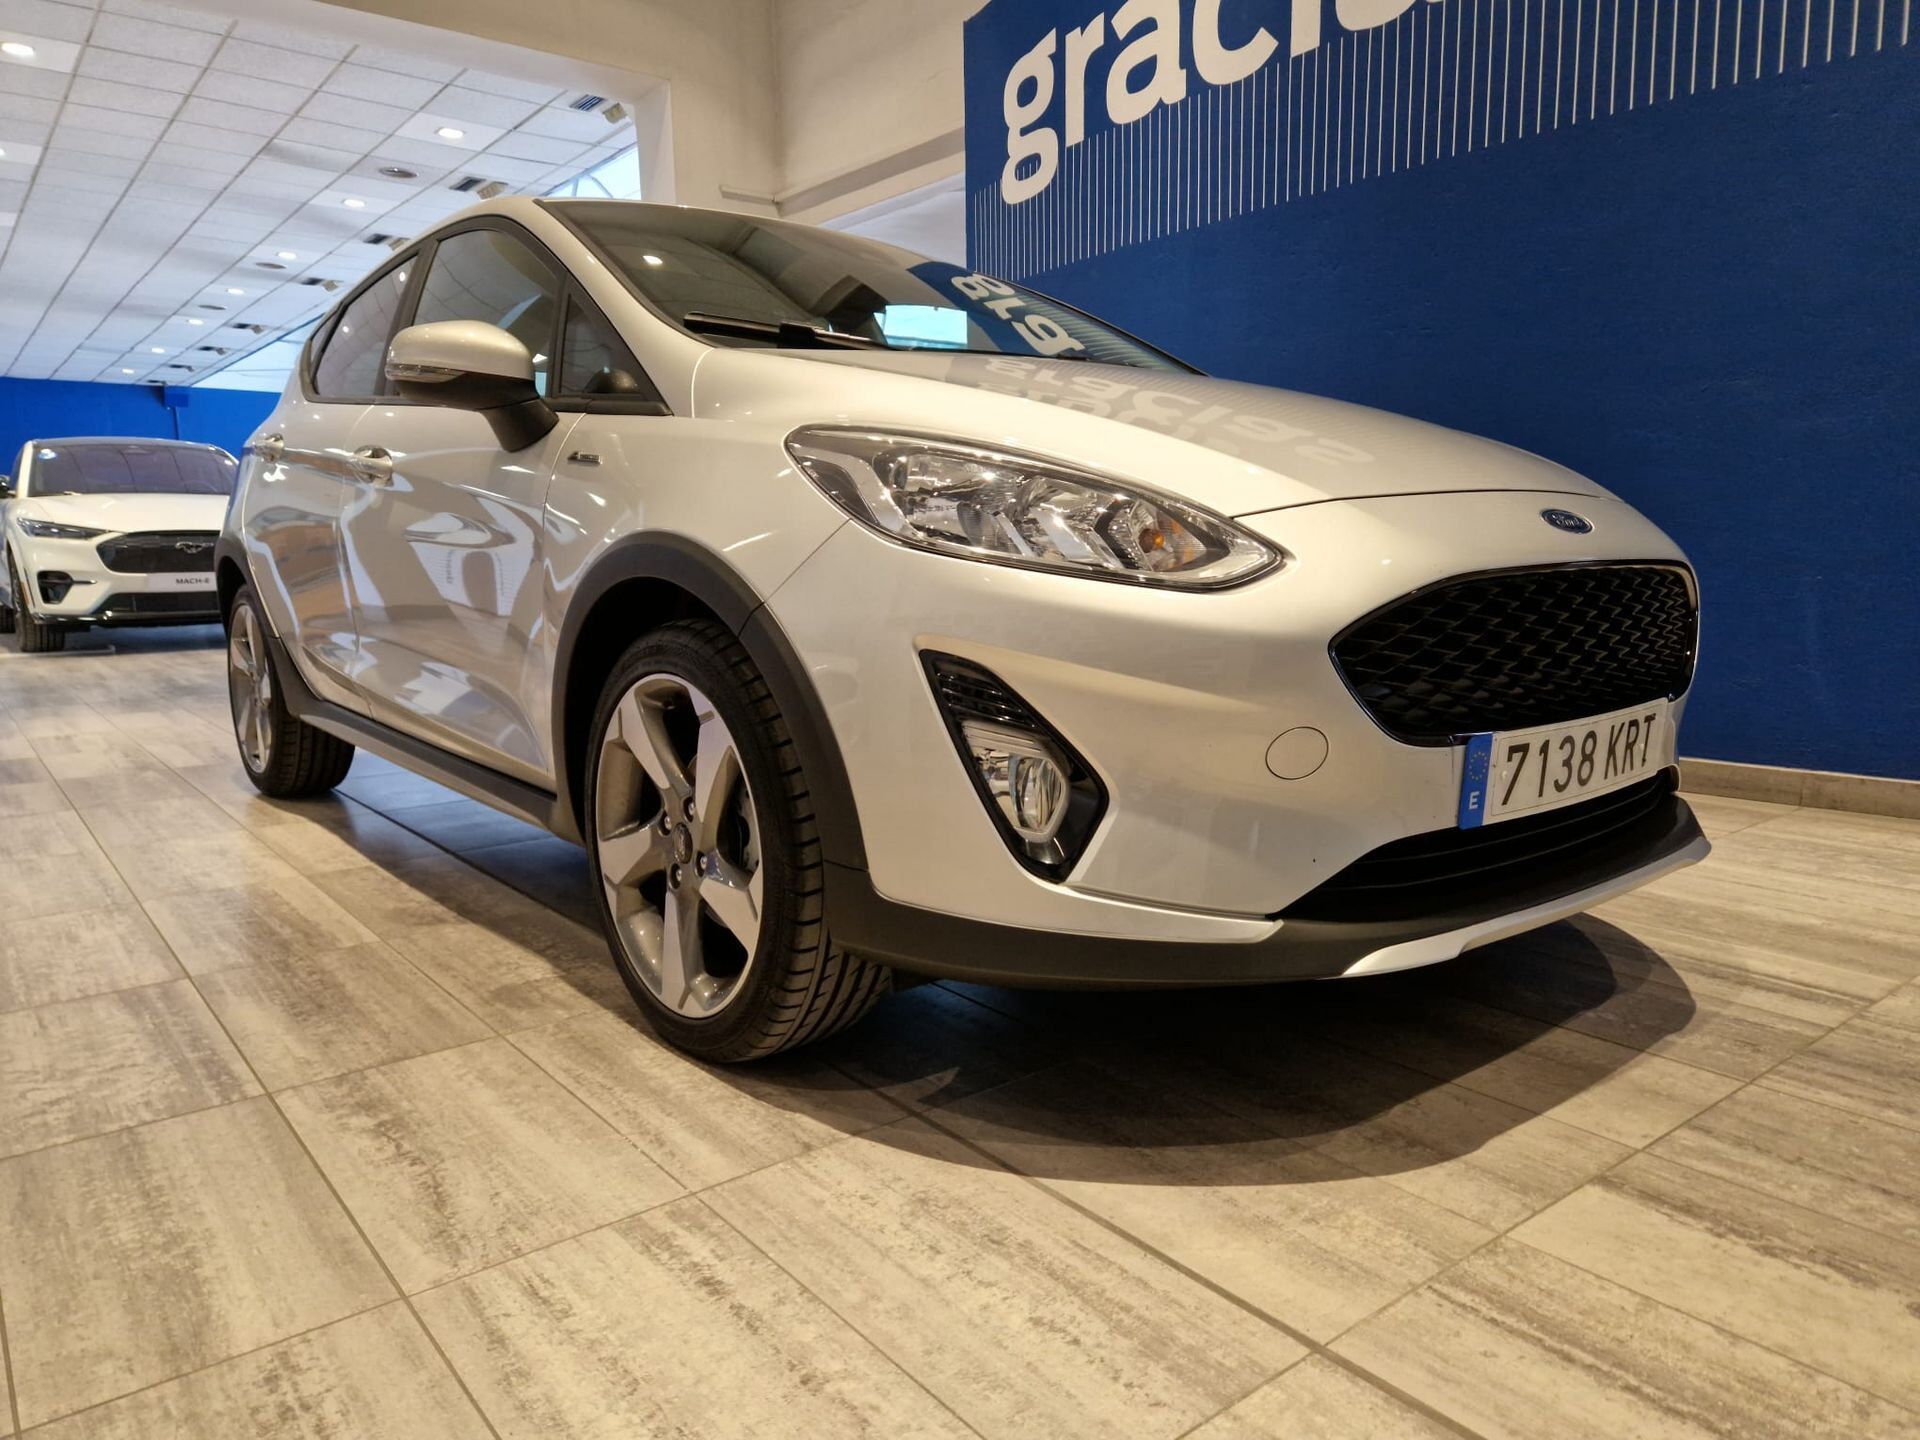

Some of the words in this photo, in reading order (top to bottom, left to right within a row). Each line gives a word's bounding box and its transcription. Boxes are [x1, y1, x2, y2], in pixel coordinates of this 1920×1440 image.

[1501, 730, 1598, 806] 7138
[1603, 712, 1657, 780] KRT
[1468, 791, 1480, 810] E
